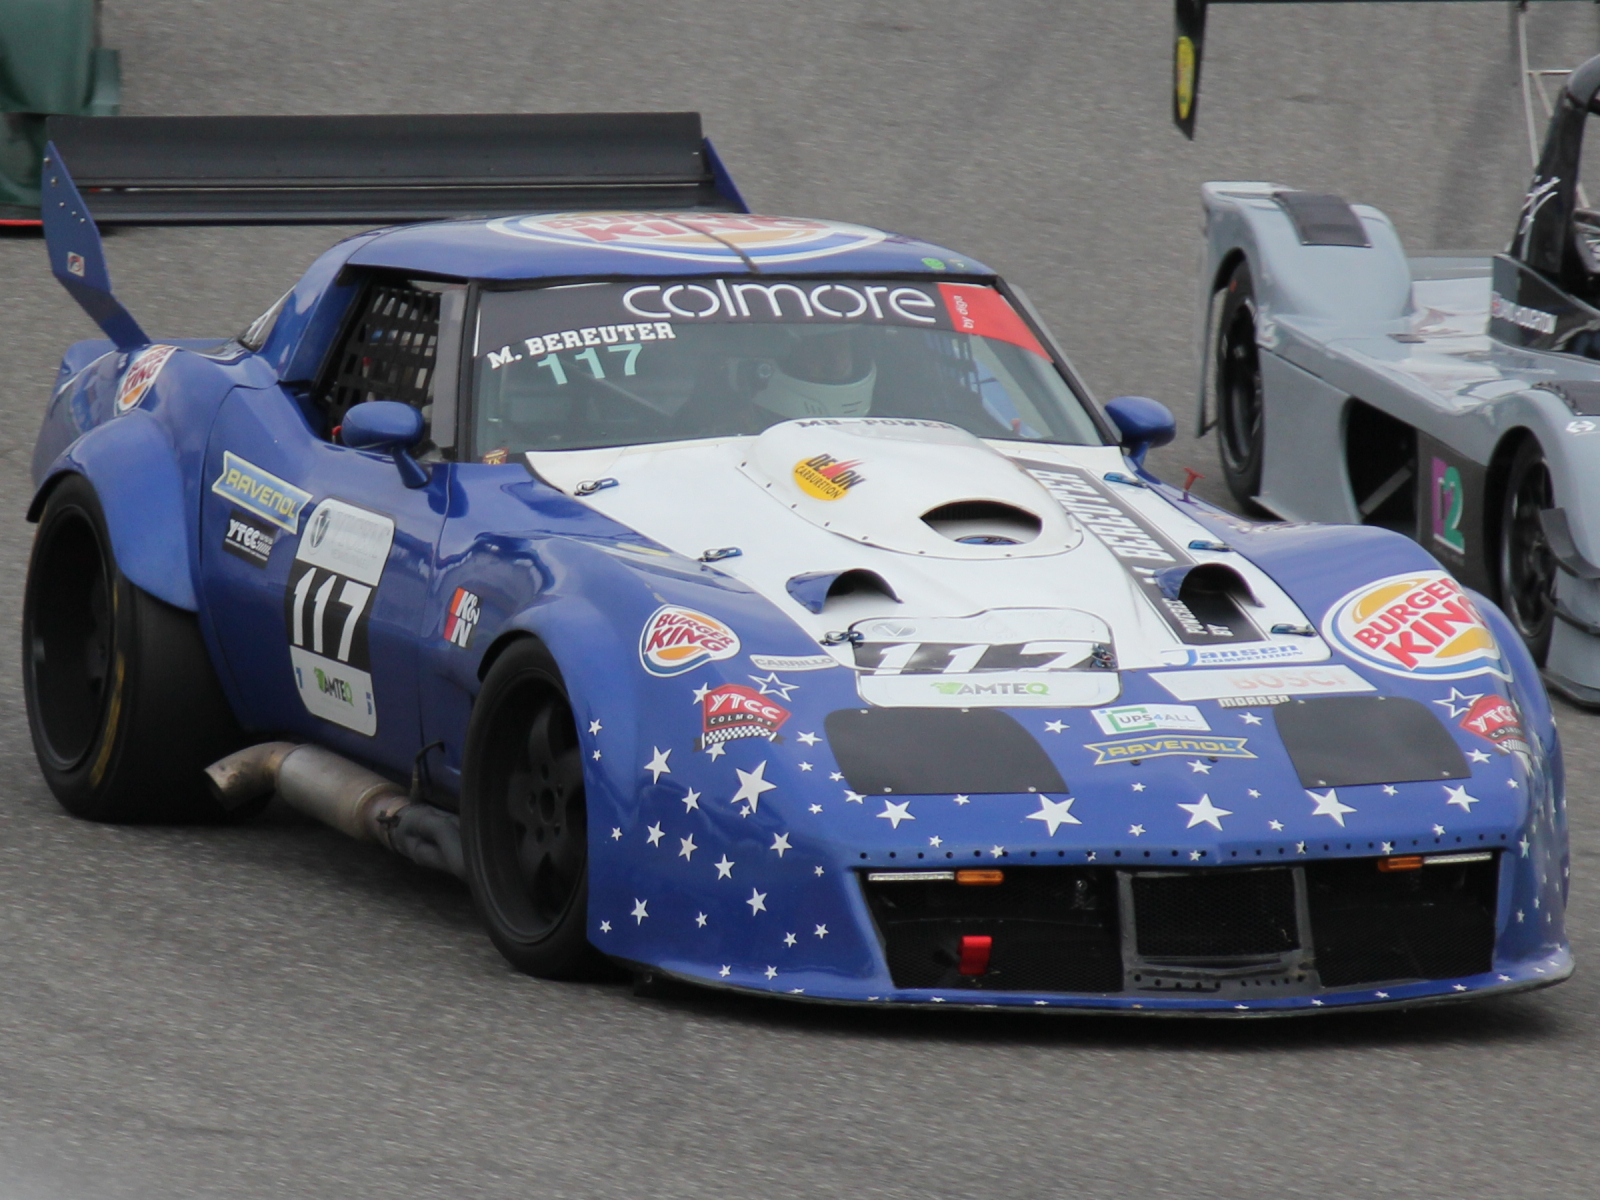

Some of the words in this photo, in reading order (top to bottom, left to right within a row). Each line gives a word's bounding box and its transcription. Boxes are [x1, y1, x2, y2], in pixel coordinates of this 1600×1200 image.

[573, 219, 829, 242] KING
[622, 279, 937, 324] colmore
[487, 345, 523, 370] M.
[525, 321, 677, 357] BEREUTER
[537, 343, 643, 385] 117
[225, 467, 298, 520] RAVENOL
[794, 465, 843, 499] CARBURETION
[1027, 468, 1177, 562] BEREUTER
[226, 518, 261, 549] YTCC
[293, 566, 373, 663] 117
[449, 589, 481, 648] K&N
[654, 613, 735, 645] BURGER
[1206, 623, 1234, 636] BY
[645, 625, 729, 652] KING
[754, 657, 835, 667] CARRILLO
[873, 641, 1097, 676] 117
[956, 681, 1050, 697] AMTEQ
[709, 692, 781, 720] YTCC
[710, 713, 773, 726] COLMORE
[1119, 713, 1196, 724] UPS4ALL
[1107, 740, 1237, 757] RAVENOL
